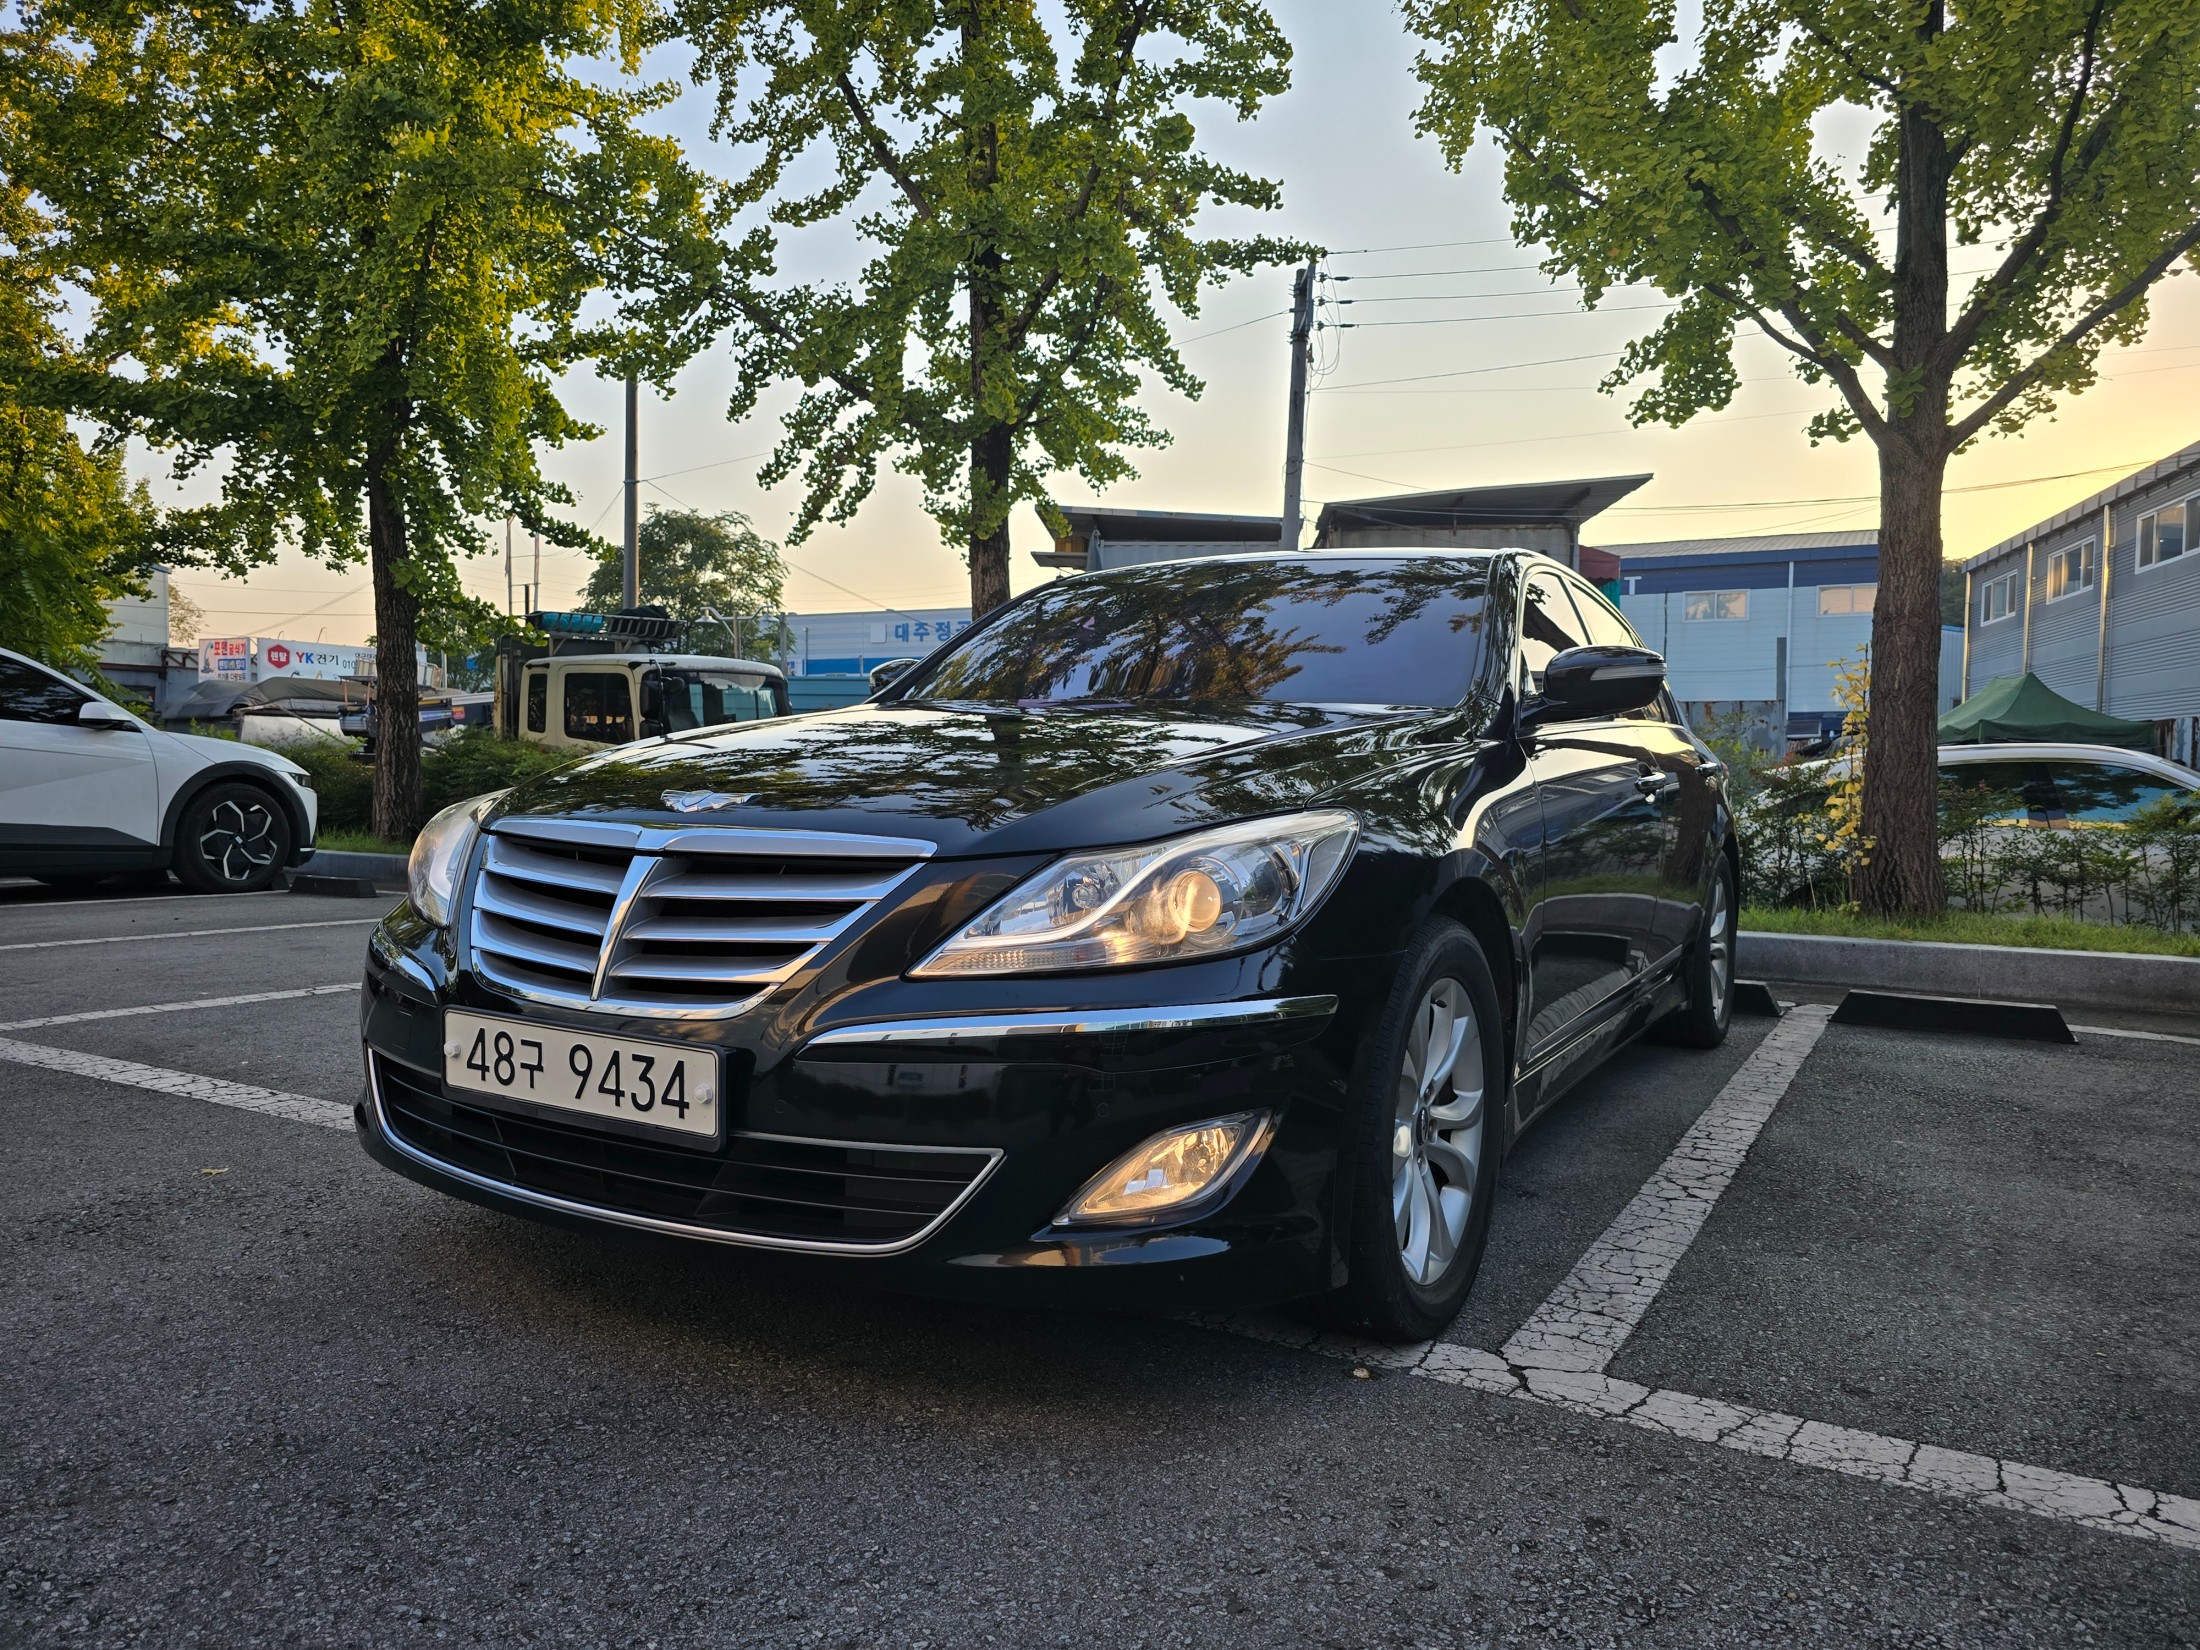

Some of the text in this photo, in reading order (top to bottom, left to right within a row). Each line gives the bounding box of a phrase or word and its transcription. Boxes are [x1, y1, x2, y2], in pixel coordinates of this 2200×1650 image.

[270, 651, 287, 662] 렌탈
[296, 652, 314, 664] YK
[316, 653, 339, 666] 건기
[466, 1027, 690, 1119] 48구 9434
